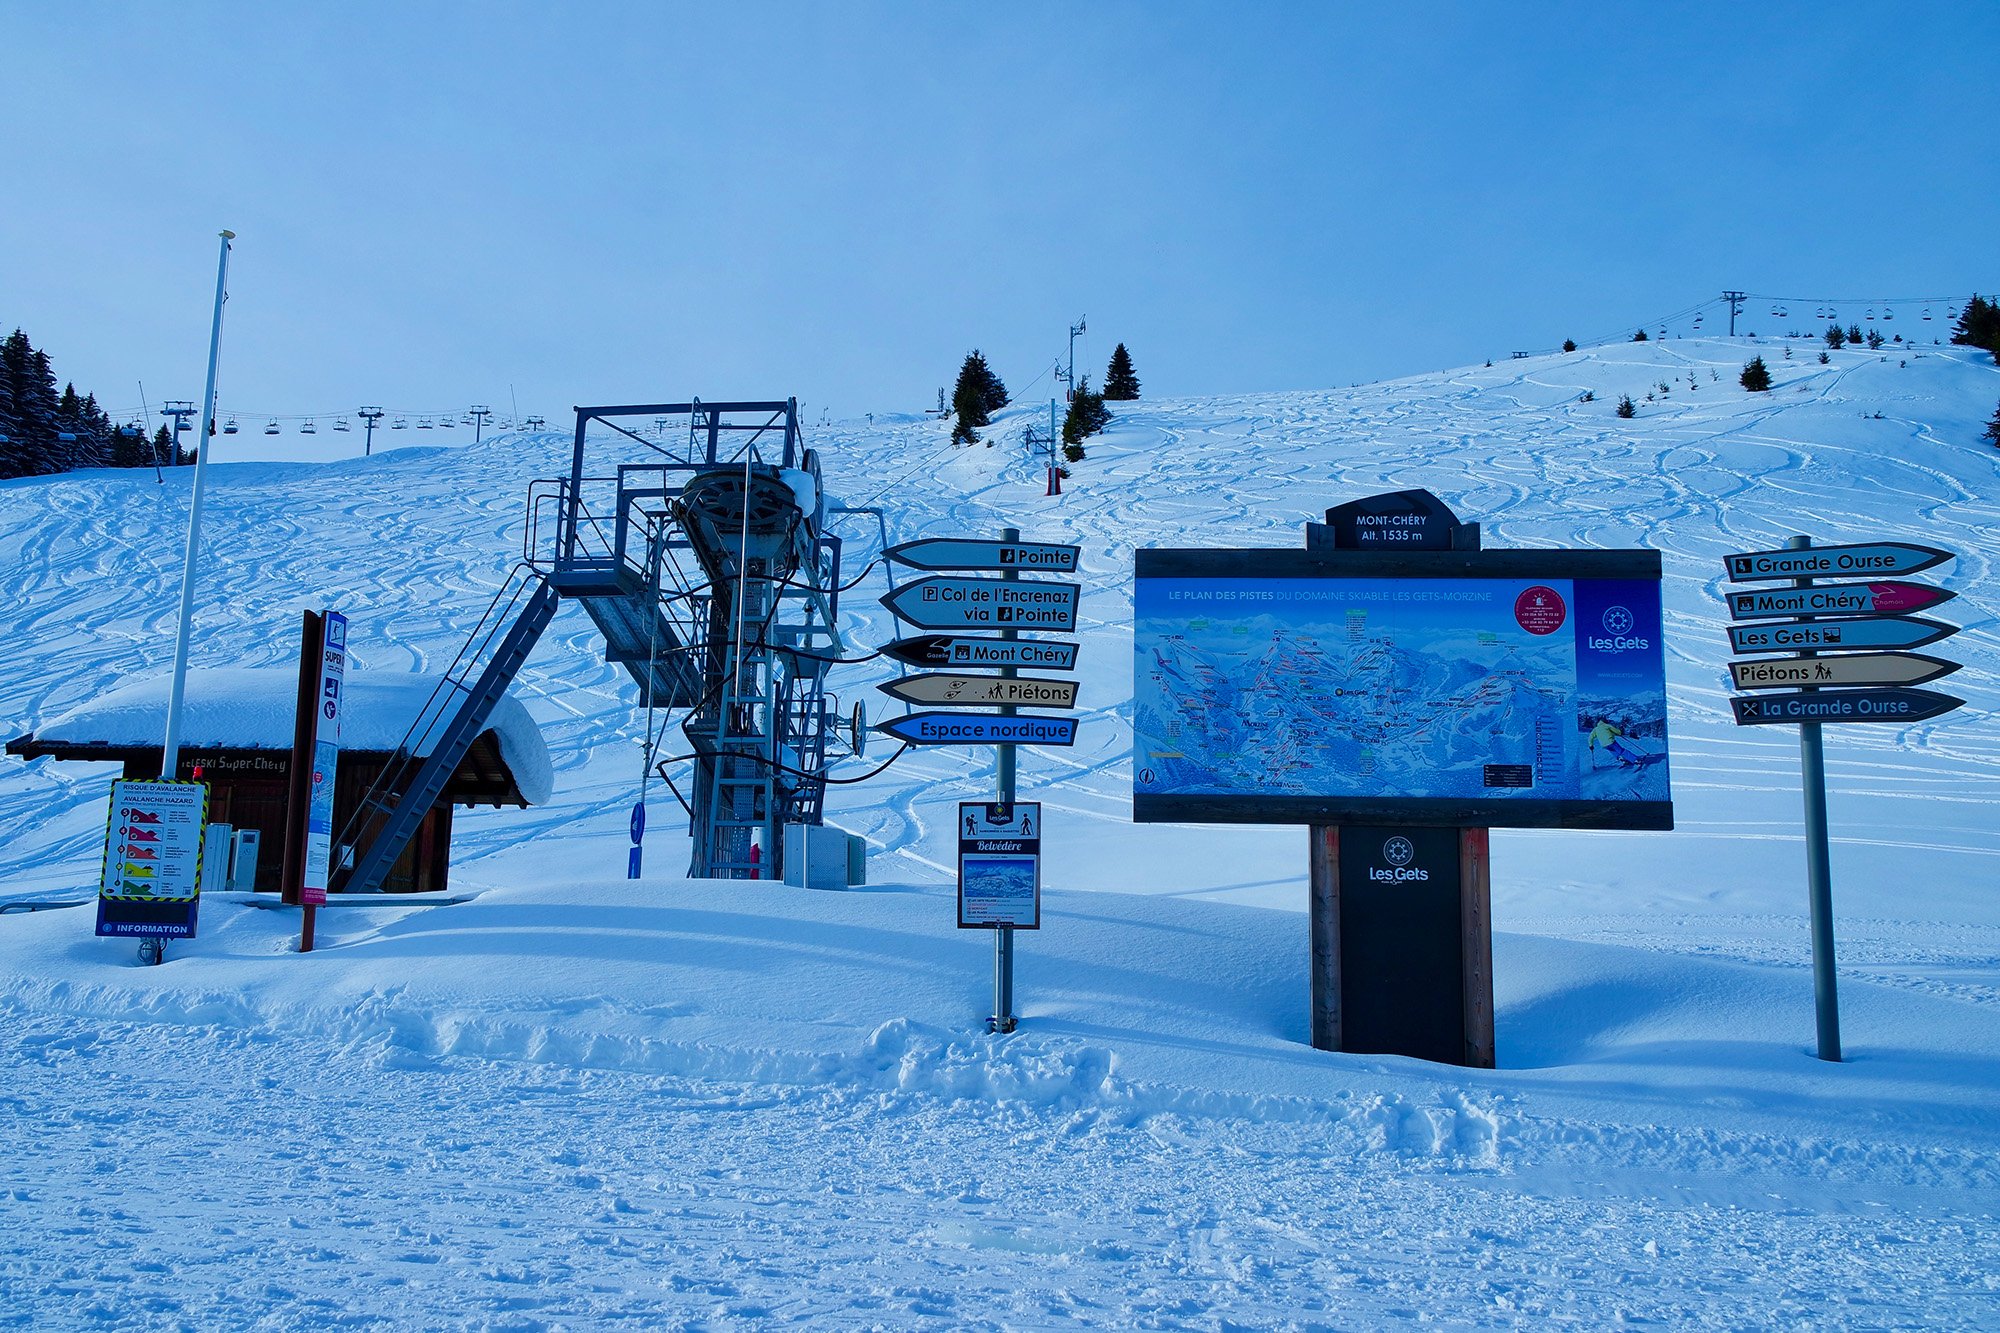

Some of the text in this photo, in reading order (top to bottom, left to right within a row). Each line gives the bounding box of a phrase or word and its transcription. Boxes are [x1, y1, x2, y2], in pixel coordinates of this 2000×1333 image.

[1356, 513, 1426, 525] MONT-CHÉRY
[1362, 530, 1378, 540] Alt.
[1382, 530, 1409, 540] 1535
[1018, 549, 1071, 564] Pointe
[1756, 554, 1896, 572] Grande Ourse
[942, 588, 966, 602] Col
[970, 588, 990, 602] de
[994, 588, 1069, 604] l'Encrenaz
[1168, 592, 1492, 601] LE PLAN DES PISTES DU DOMAINE SKIABLE LES GETS-MORZINE
[1758, 590, 1866, 610] Mont Chéry
[964, 606, 1068, 623] via Pointe
[1589, 636, 1649, 650] Les Gets
[1738, 628, 1820, 645] Les Gets
[974, 646, 1070, 664] Mont Chéry
[1740, 664, 1809, 681] Piétons
[1008, 683, 1070, 700] Piétons
[1763, 699, 1909, 716] La Grande Ourse
[920, 722, 1069, 740] Espace nordique
[977, 840, 1022, 851] Belvédère
[1370, 867, 1429, 880] Les Gets
[117, 924, 188, 933] INFORMATION
